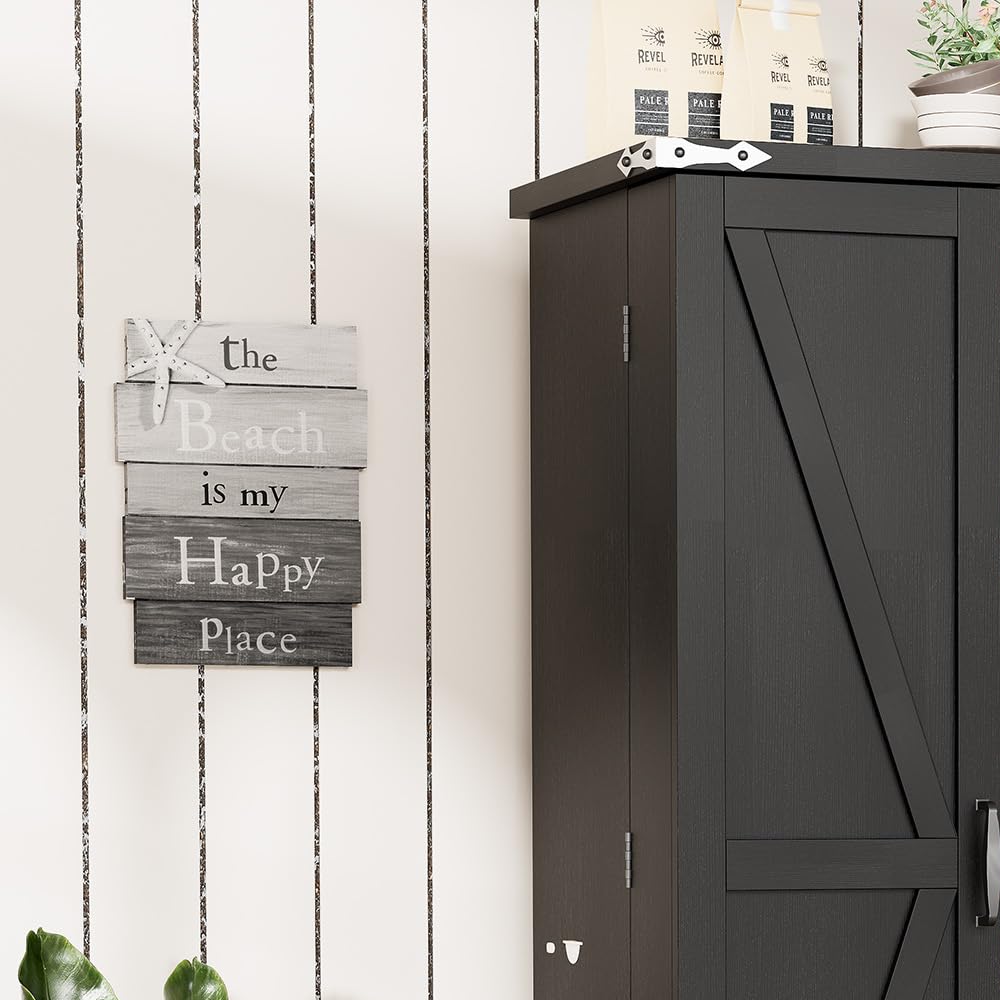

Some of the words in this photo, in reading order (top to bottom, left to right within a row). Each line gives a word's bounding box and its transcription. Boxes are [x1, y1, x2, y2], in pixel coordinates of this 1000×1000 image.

[638, 49, 666, 64] REVEL
[771, 71, 791, 83] REVEL
[640, 96, 662, 105] PALE
[693, 98, 715, 108] PALE
[773, 108, 789, 117] PALE
[810, 112, 825, 120] PALE
[220, 335, 278, 372] the
[174, 399, 327, 456] Beach
[201, 471, 226, 506] is
[240, 485, 288, 513] my
[173, 536, 325, 593] Happy
[200, 616, 297, 655] Place
